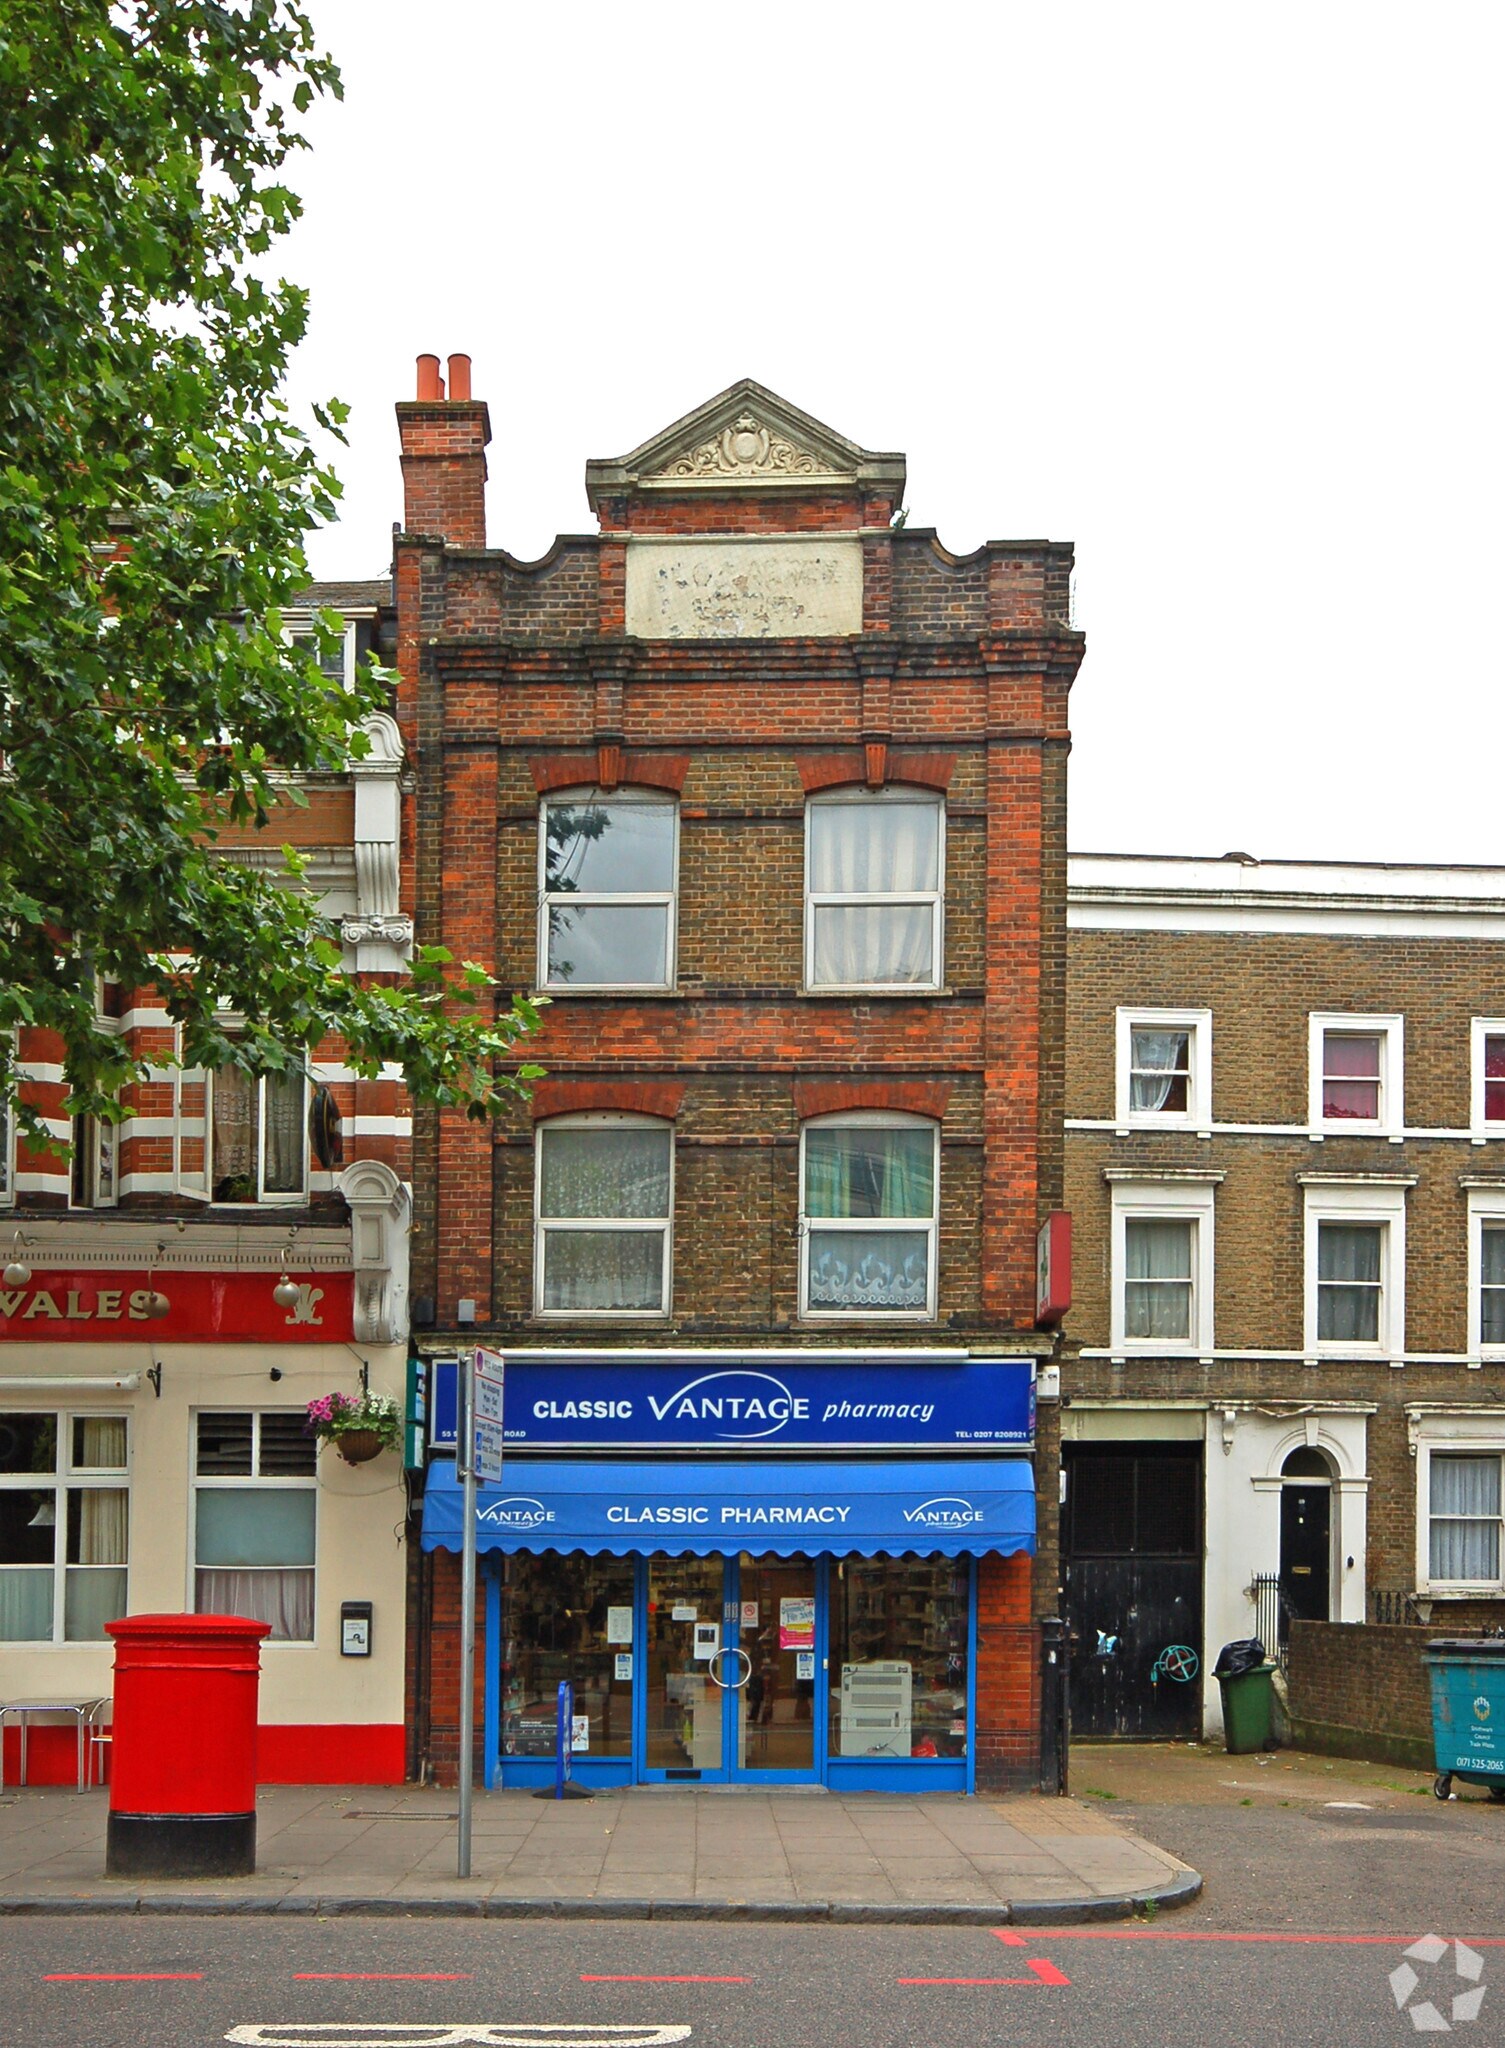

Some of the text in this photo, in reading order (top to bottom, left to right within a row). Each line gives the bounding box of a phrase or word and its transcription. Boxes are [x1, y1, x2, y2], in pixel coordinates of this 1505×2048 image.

[533, 1374, 935, 1422] CLASSIC VANTAGE pharmacy
[504, 1430, 526, 1438] ROAD
[475, 1500, 556, 1523] VANTAGE
[607, 1506, 851, 1524] CLASSIC PHARMACY
[903, 1500, 984, 1523] VANTAGE
